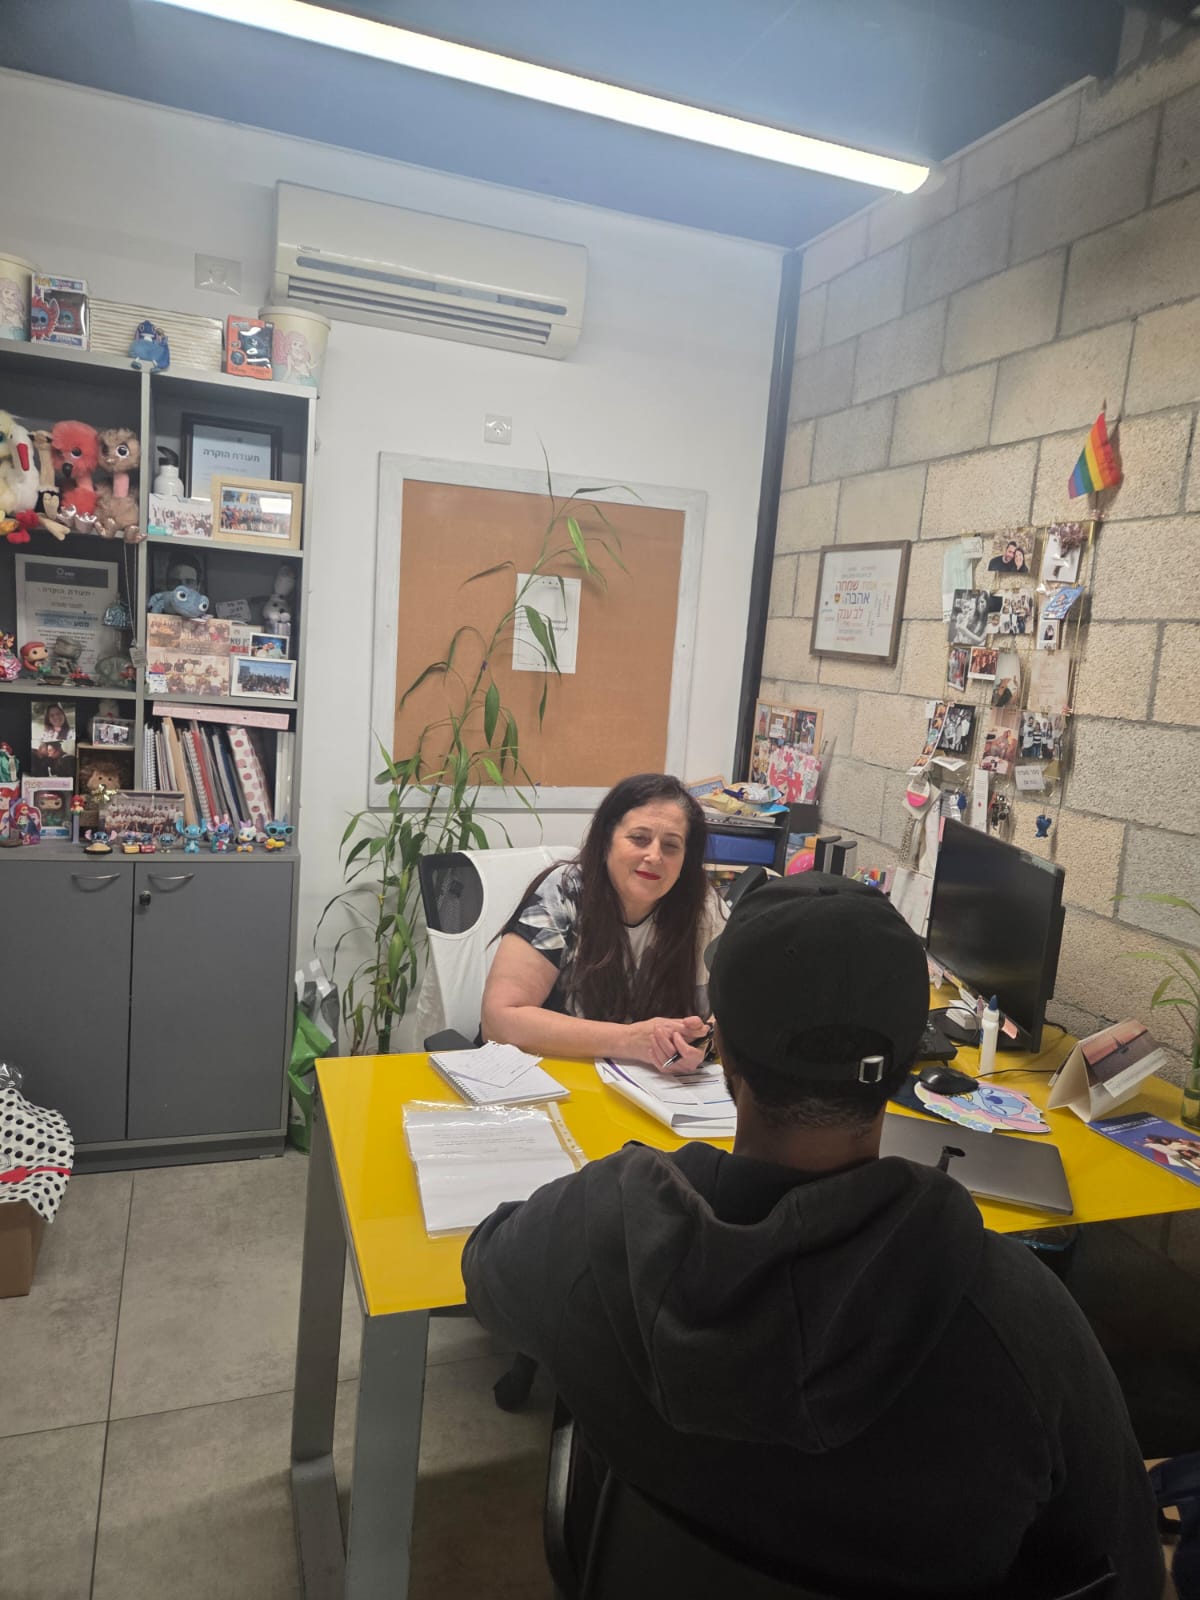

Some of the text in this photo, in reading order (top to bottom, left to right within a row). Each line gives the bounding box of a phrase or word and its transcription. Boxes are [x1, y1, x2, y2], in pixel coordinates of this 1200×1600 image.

[203, 448, 260, 462] תעודת הוקרה
[836, 580, 859, 592] שמחה
[845, 592, 871, 605] אהבה
[837, 608, 853, 623] ענק
[853, 608, 864, 620] לב
